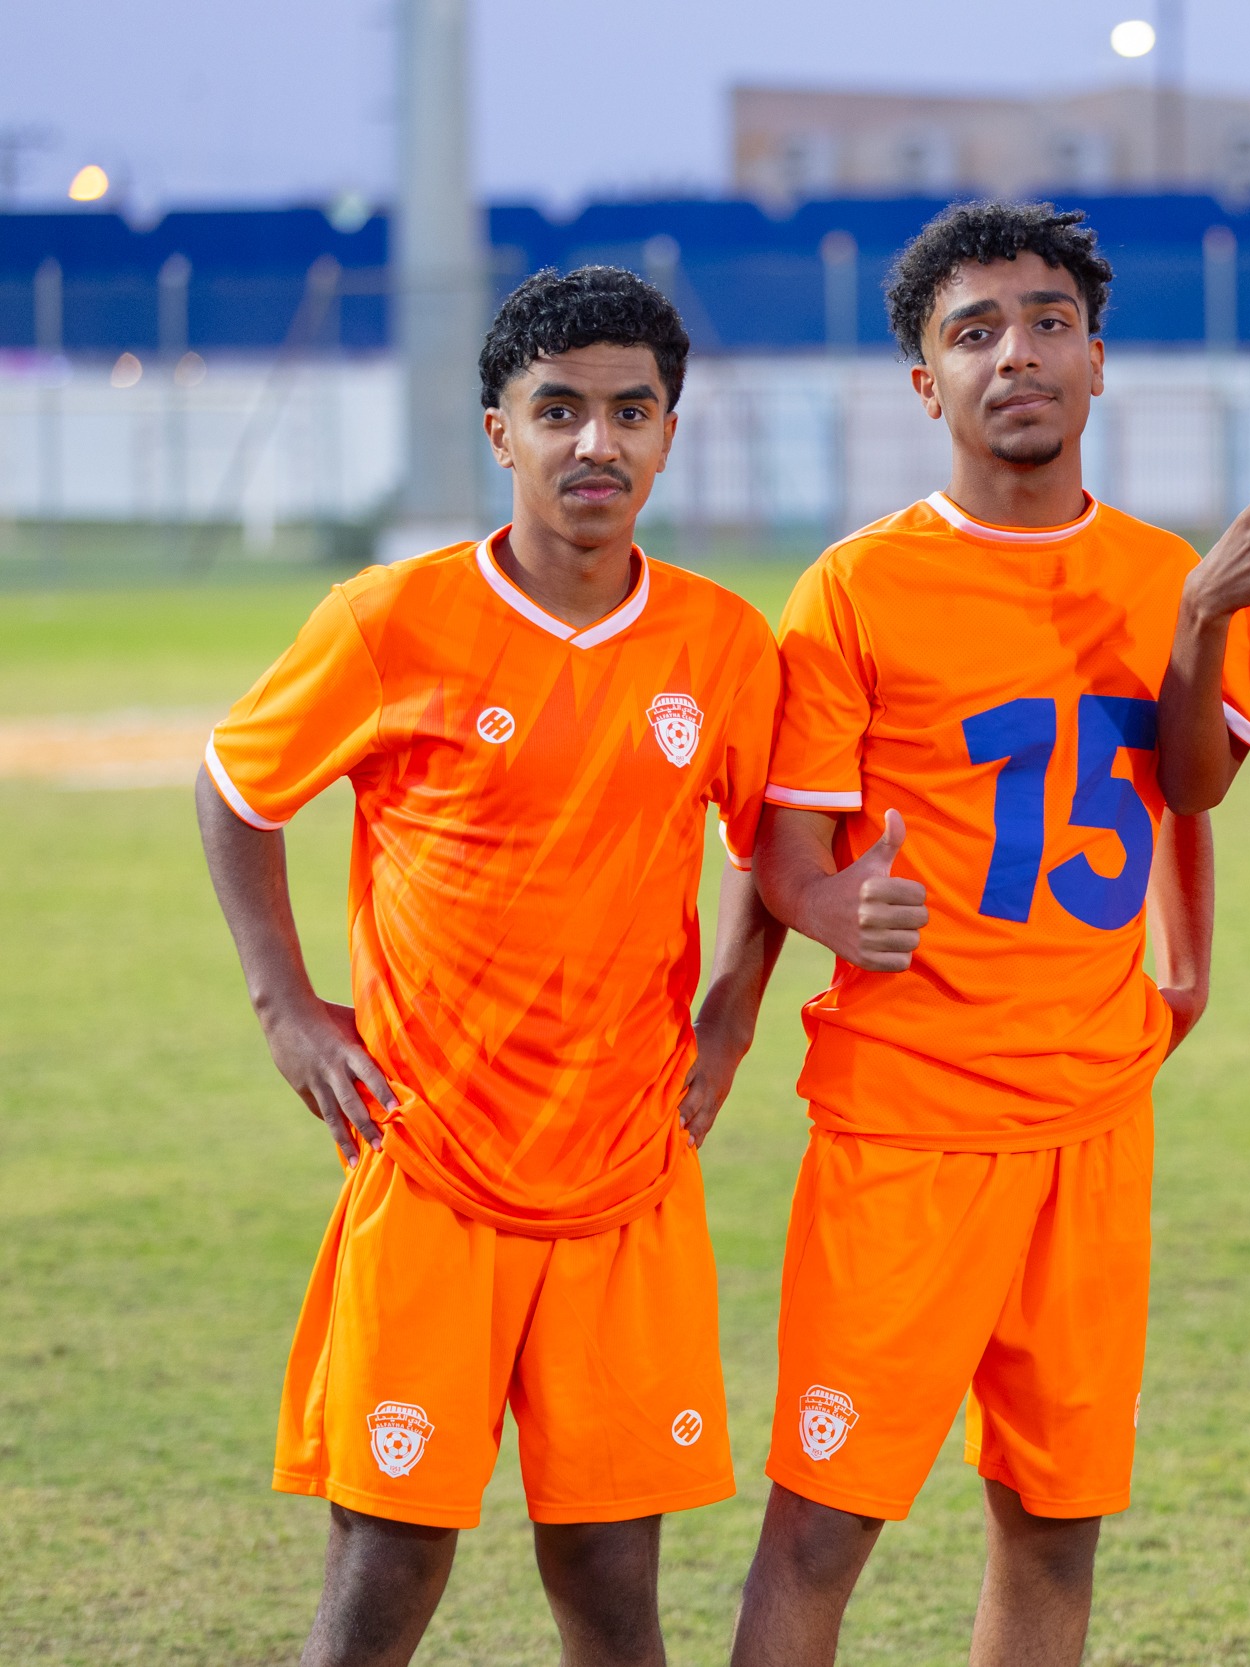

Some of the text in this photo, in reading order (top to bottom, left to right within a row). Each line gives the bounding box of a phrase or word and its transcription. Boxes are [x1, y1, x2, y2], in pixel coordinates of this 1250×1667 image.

[961, 694, 1157, 930] 15
[832, 1412, 847, 1422] CLUB
[407, 1426, 423, 1435] CLUB
